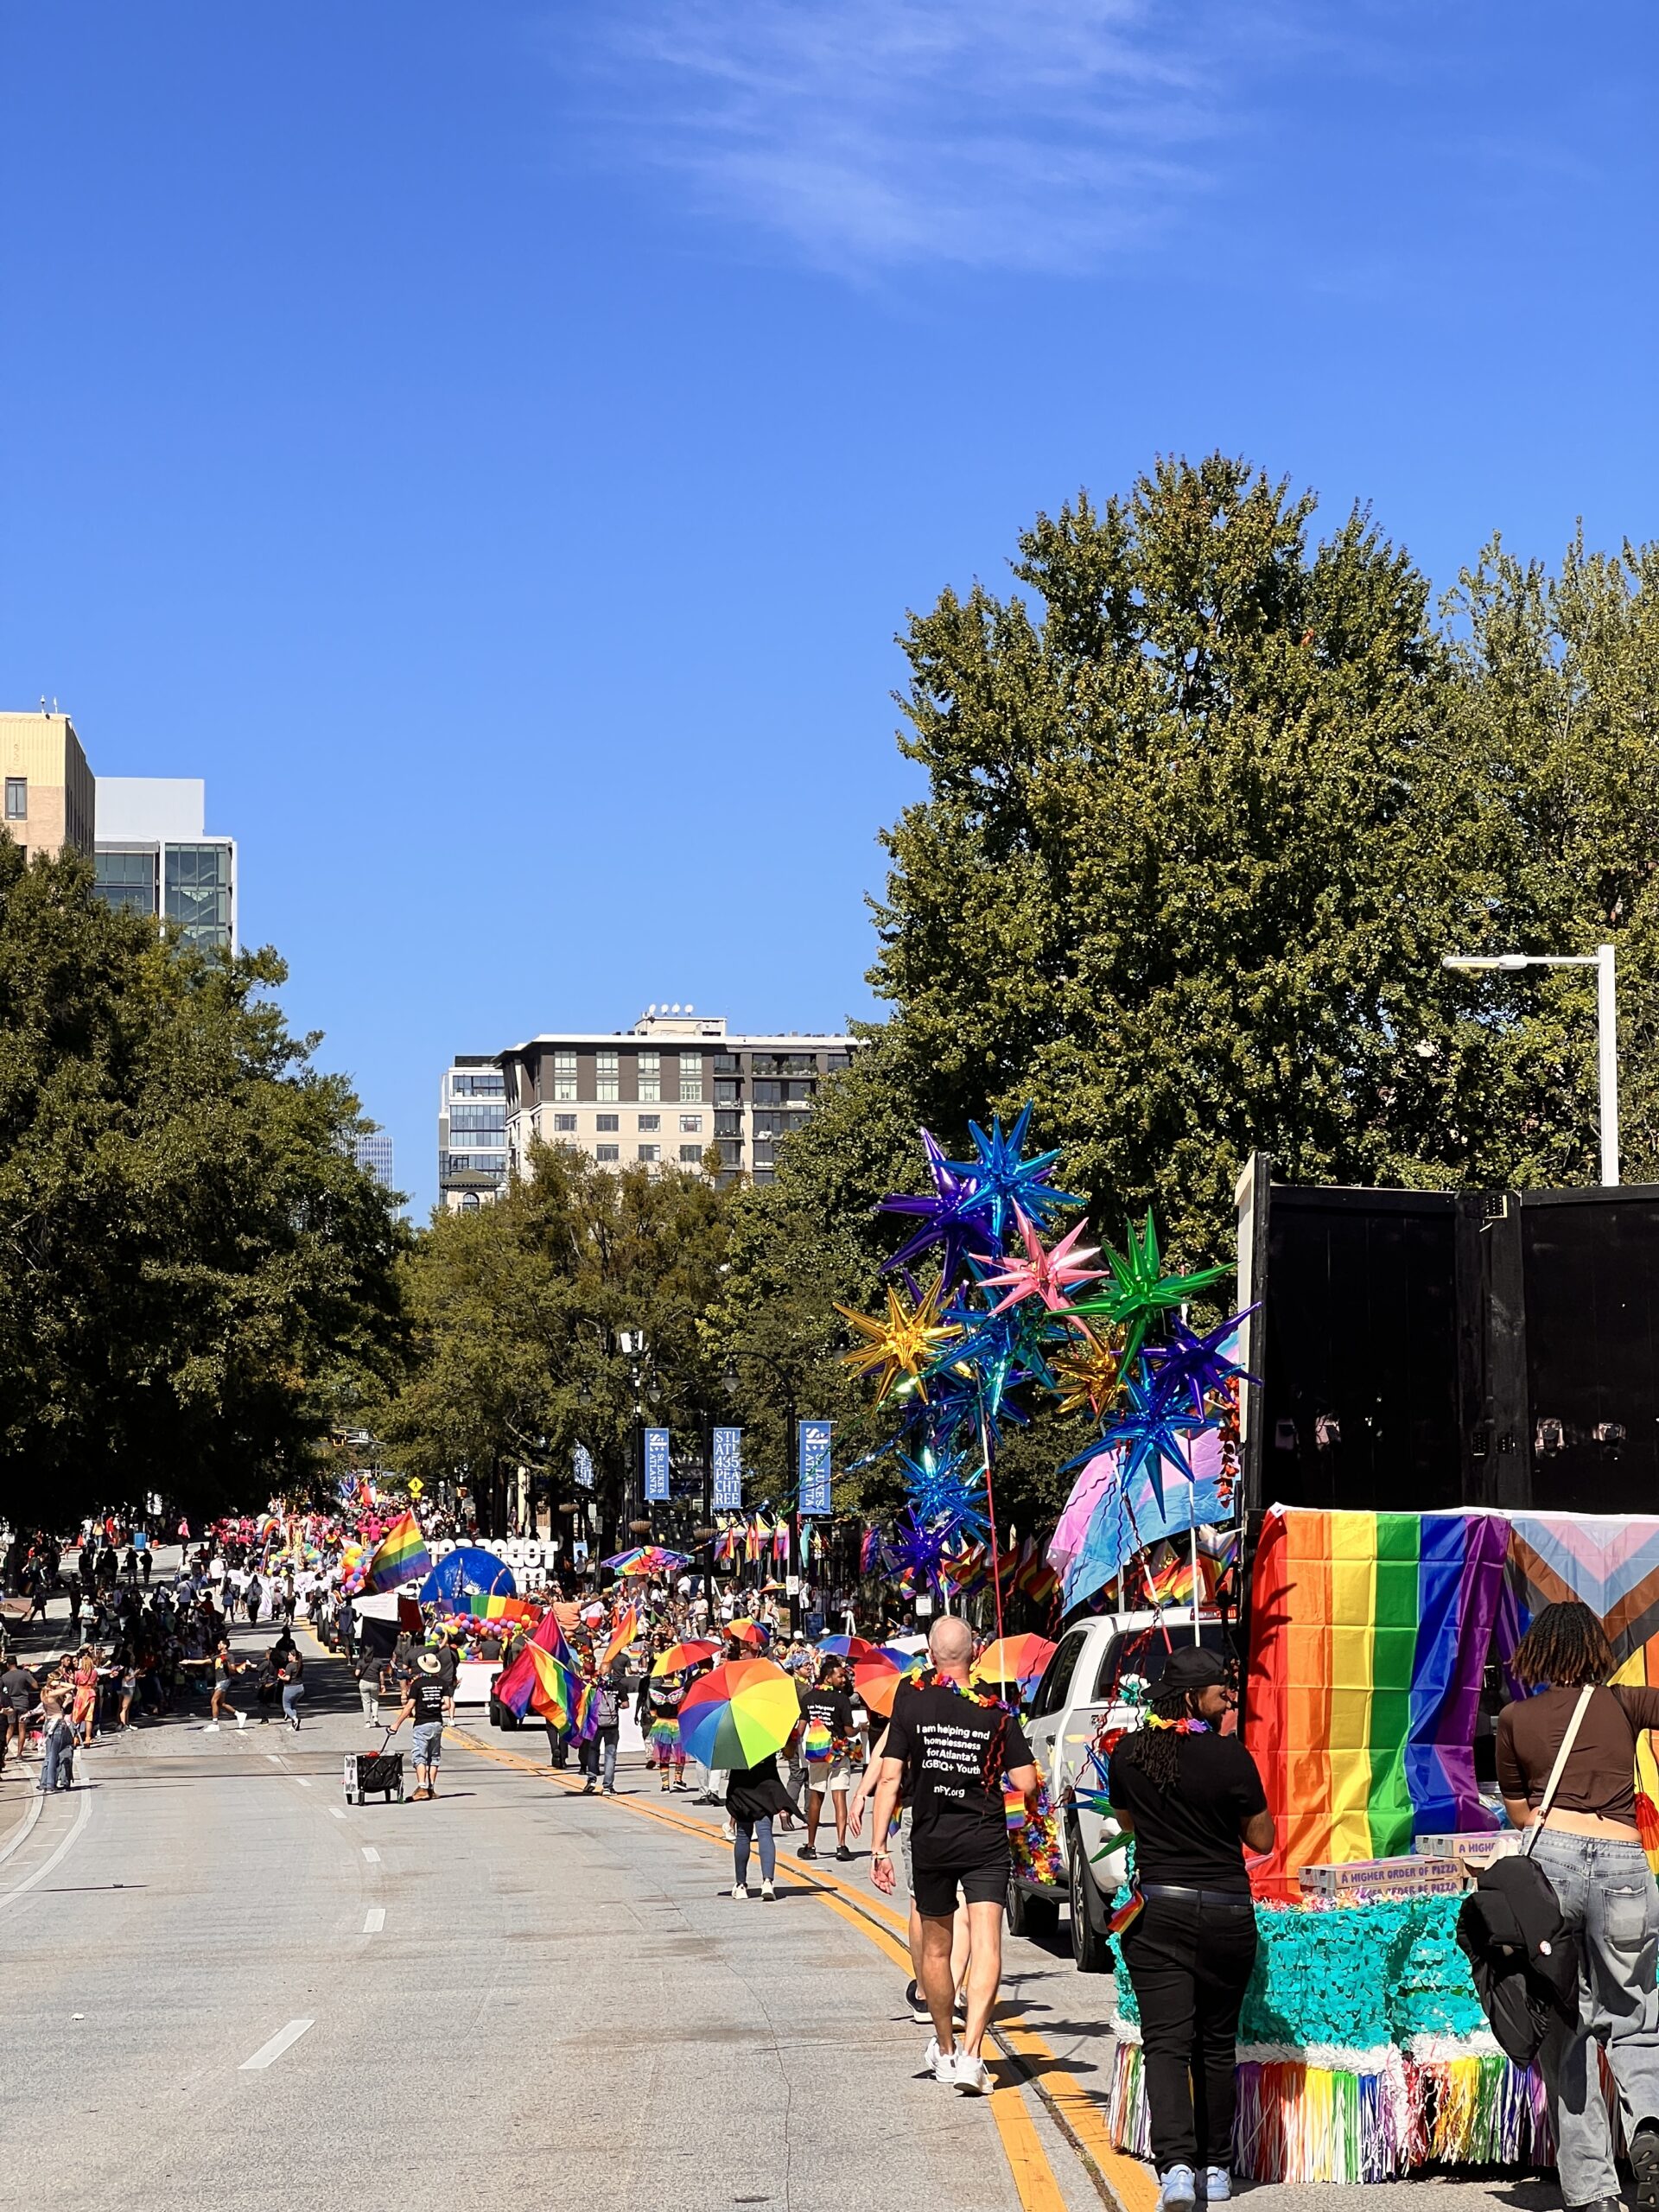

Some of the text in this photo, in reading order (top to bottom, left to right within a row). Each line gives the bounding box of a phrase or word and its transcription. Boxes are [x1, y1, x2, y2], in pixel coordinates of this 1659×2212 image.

[715, 1455, 739, 1468] 435
[715, 1468, 740, 1480] PEA
[715, 1480, 740, 1492] CHT
[715, 1492, 739, 1504] REE
[916, 1723, 990, 1740] I am helping end
[924, 1736, 982, 1751] homelessness
[926, 1747, 978, 1763] for Atlanta's
[956, 1763, 981, 1775] Youth
[1459, 1842, 1496, 1853] A HIGH
[1341, 1863, 1458, 1884] A HIGHER ORDER OF PIZZA
